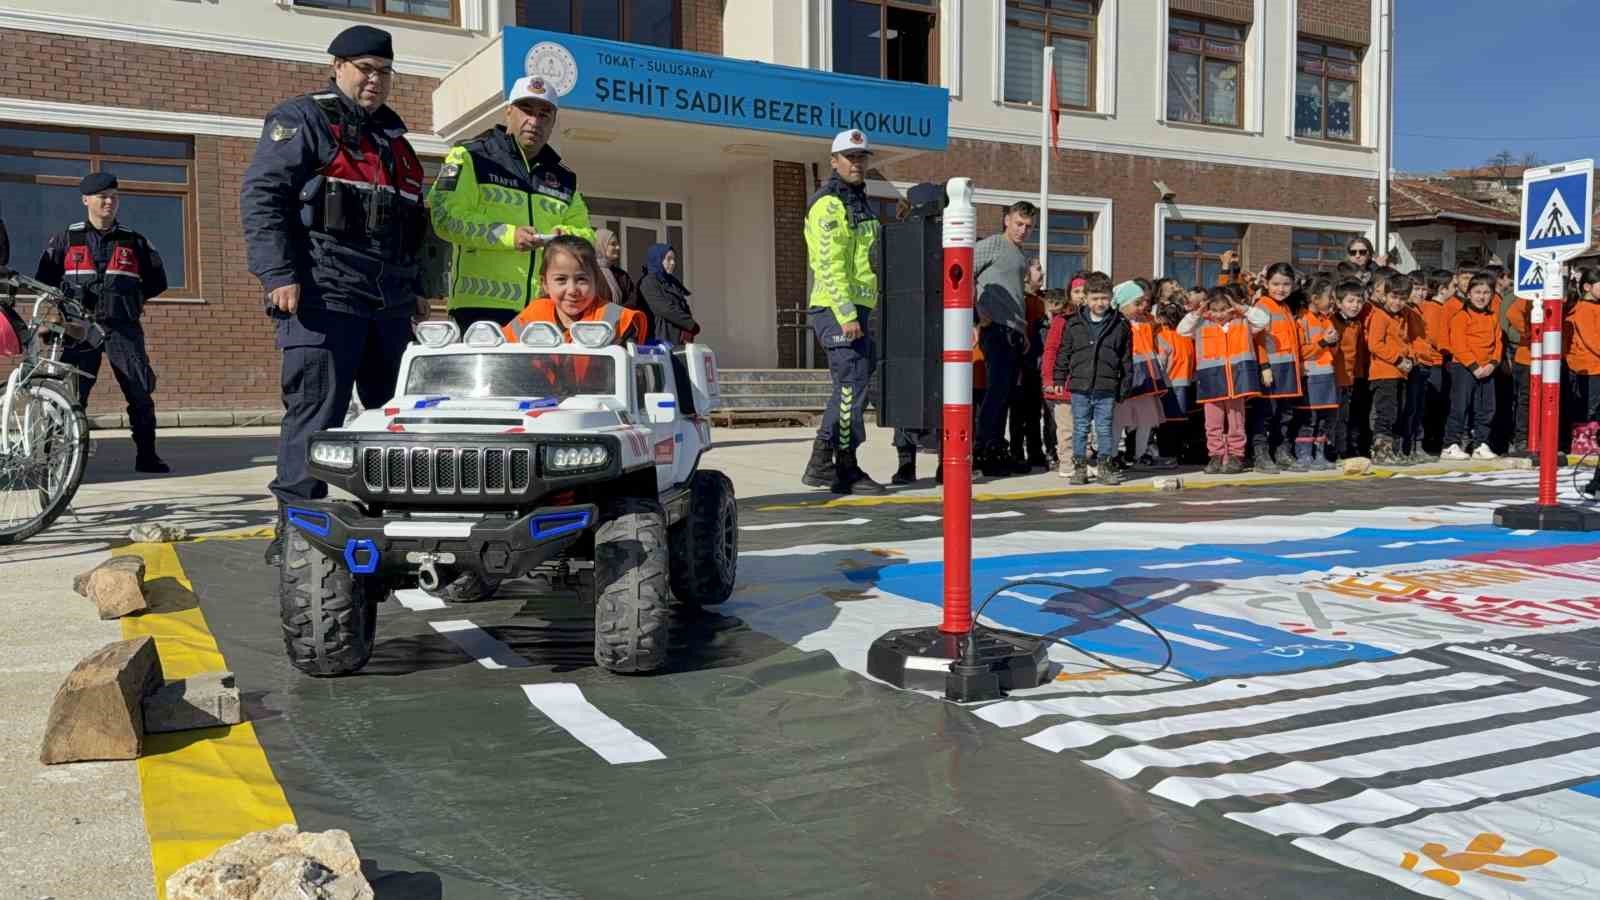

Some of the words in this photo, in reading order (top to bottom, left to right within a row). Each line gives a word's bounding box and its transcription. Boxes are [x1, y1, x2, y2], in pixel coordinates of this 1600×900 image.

[597, 52, 635, 69] TOKAT
[647, 60, 714, 80] SULUSARAY
[595, 77, 670, 108] ŞEHİT
[675, 88, 746, 118] SADIK
[752, 98, 824, 127] BEZER
[830, 102, 931, 137] İLKOKULU
